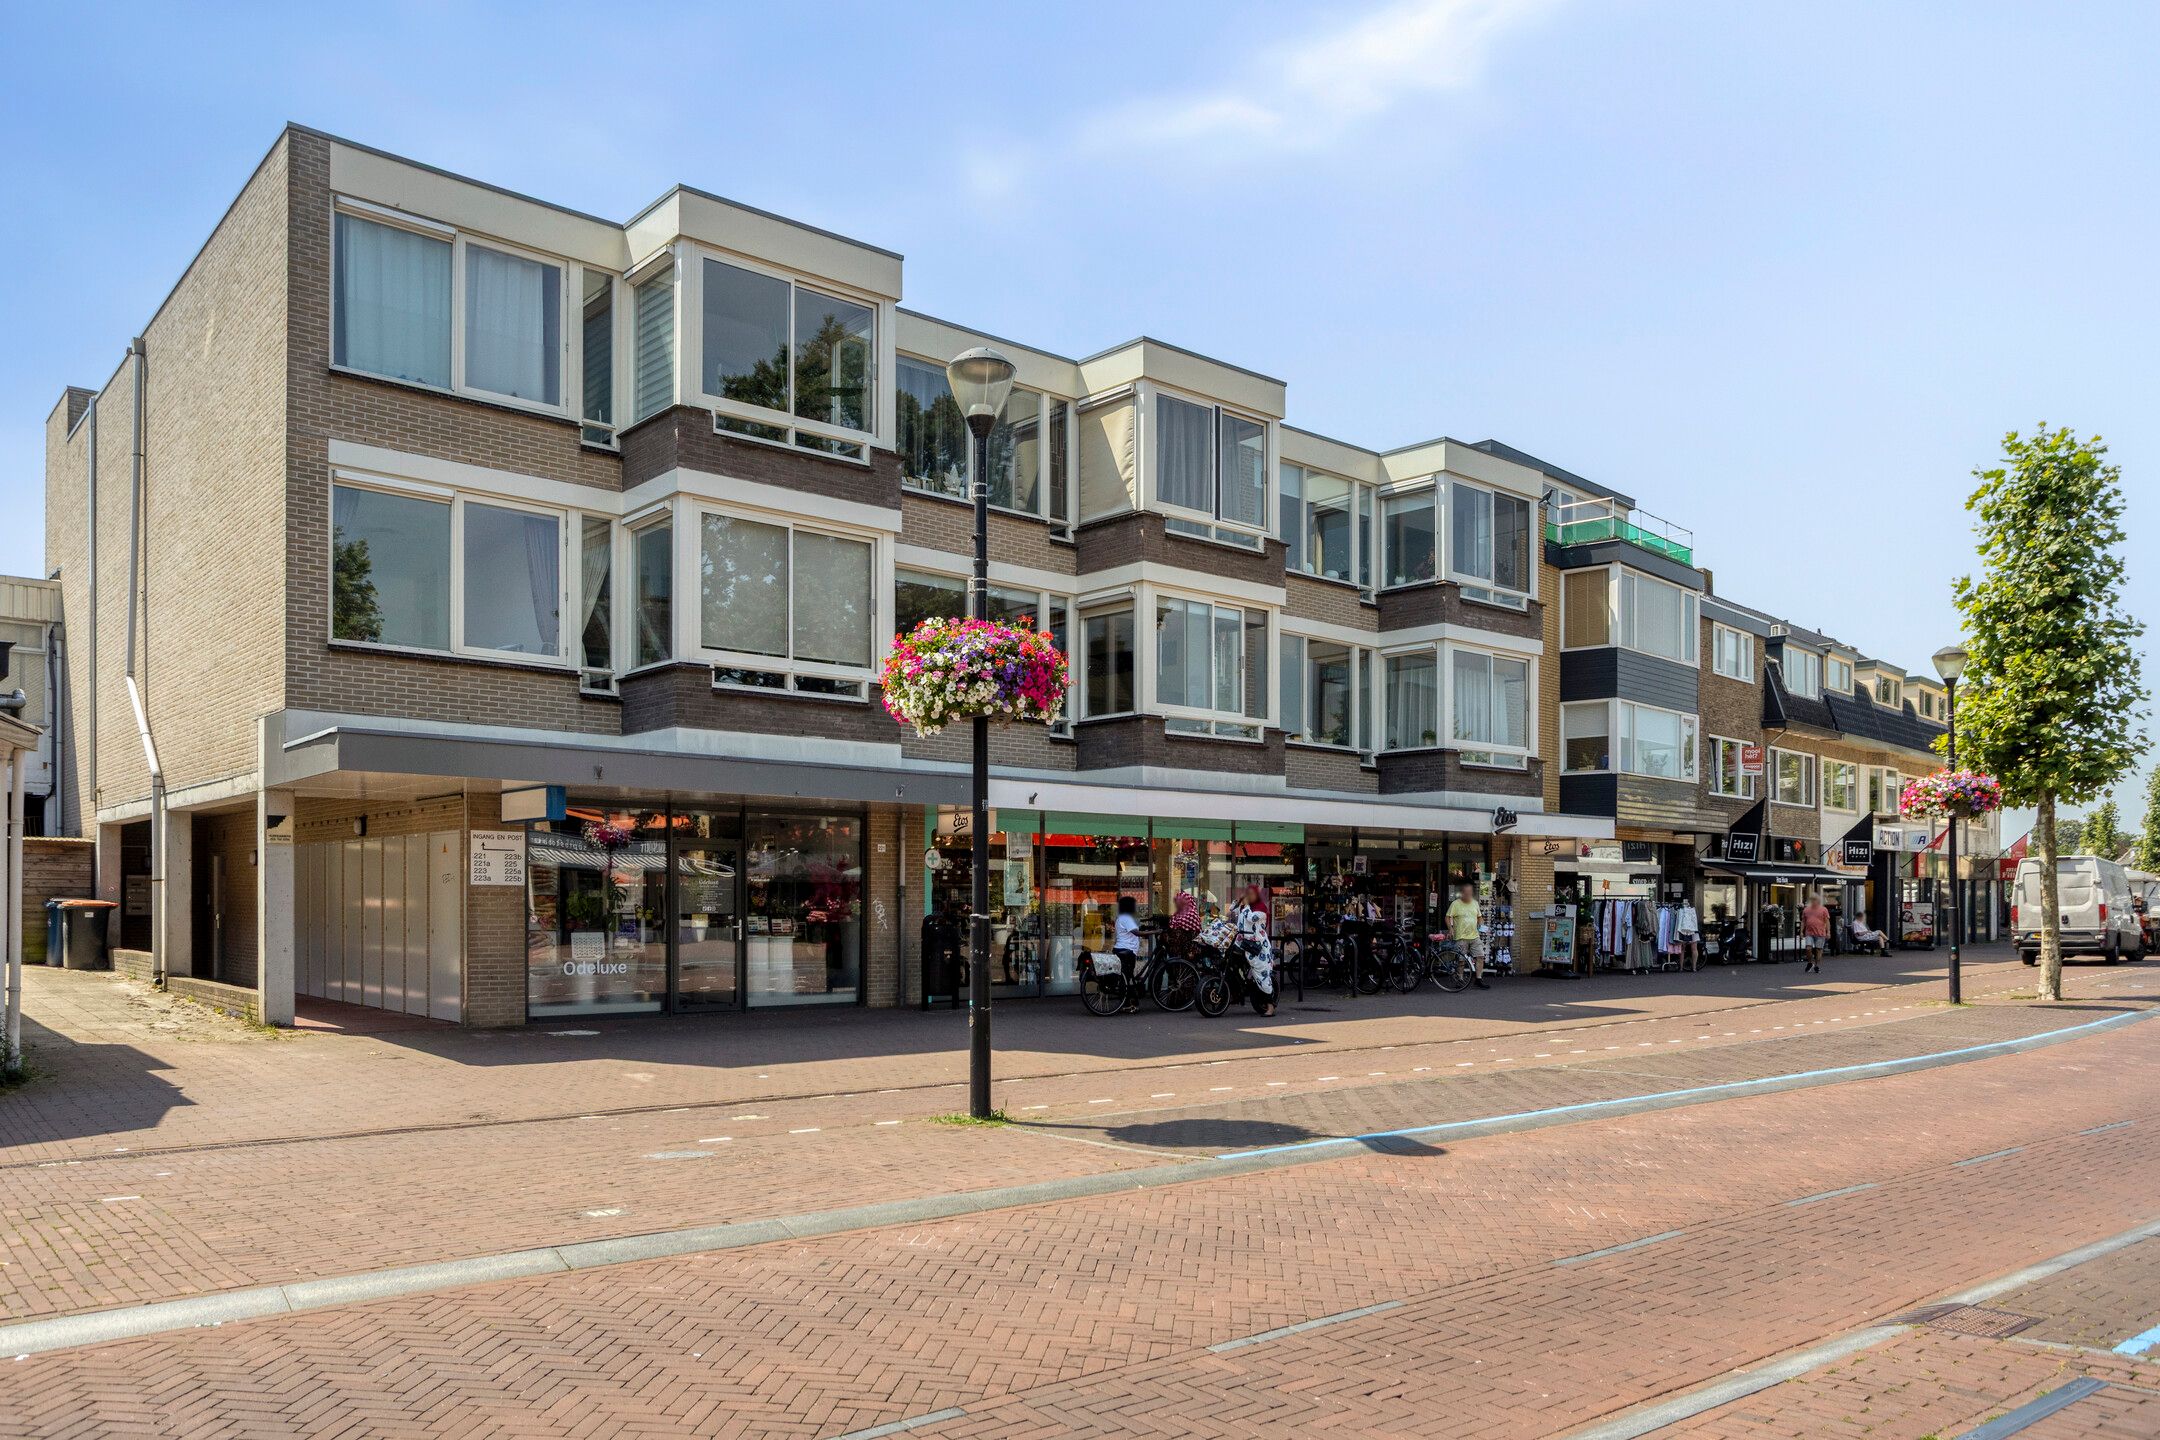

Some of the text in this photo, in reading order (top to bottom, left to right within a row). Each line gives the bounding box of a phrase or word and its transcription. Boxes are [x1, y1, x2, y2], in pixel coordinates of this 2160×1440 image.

[953, 813, 969, 830] Etos
[1494, 807, 1518, 831] Etos
[1544, 841, 1560, 853] Etos
[1733, 839, 1753, 850] HIZI
[1848, 845, 1868, 855] HIZI
[563, 960, 627, 976] Odeluxe
